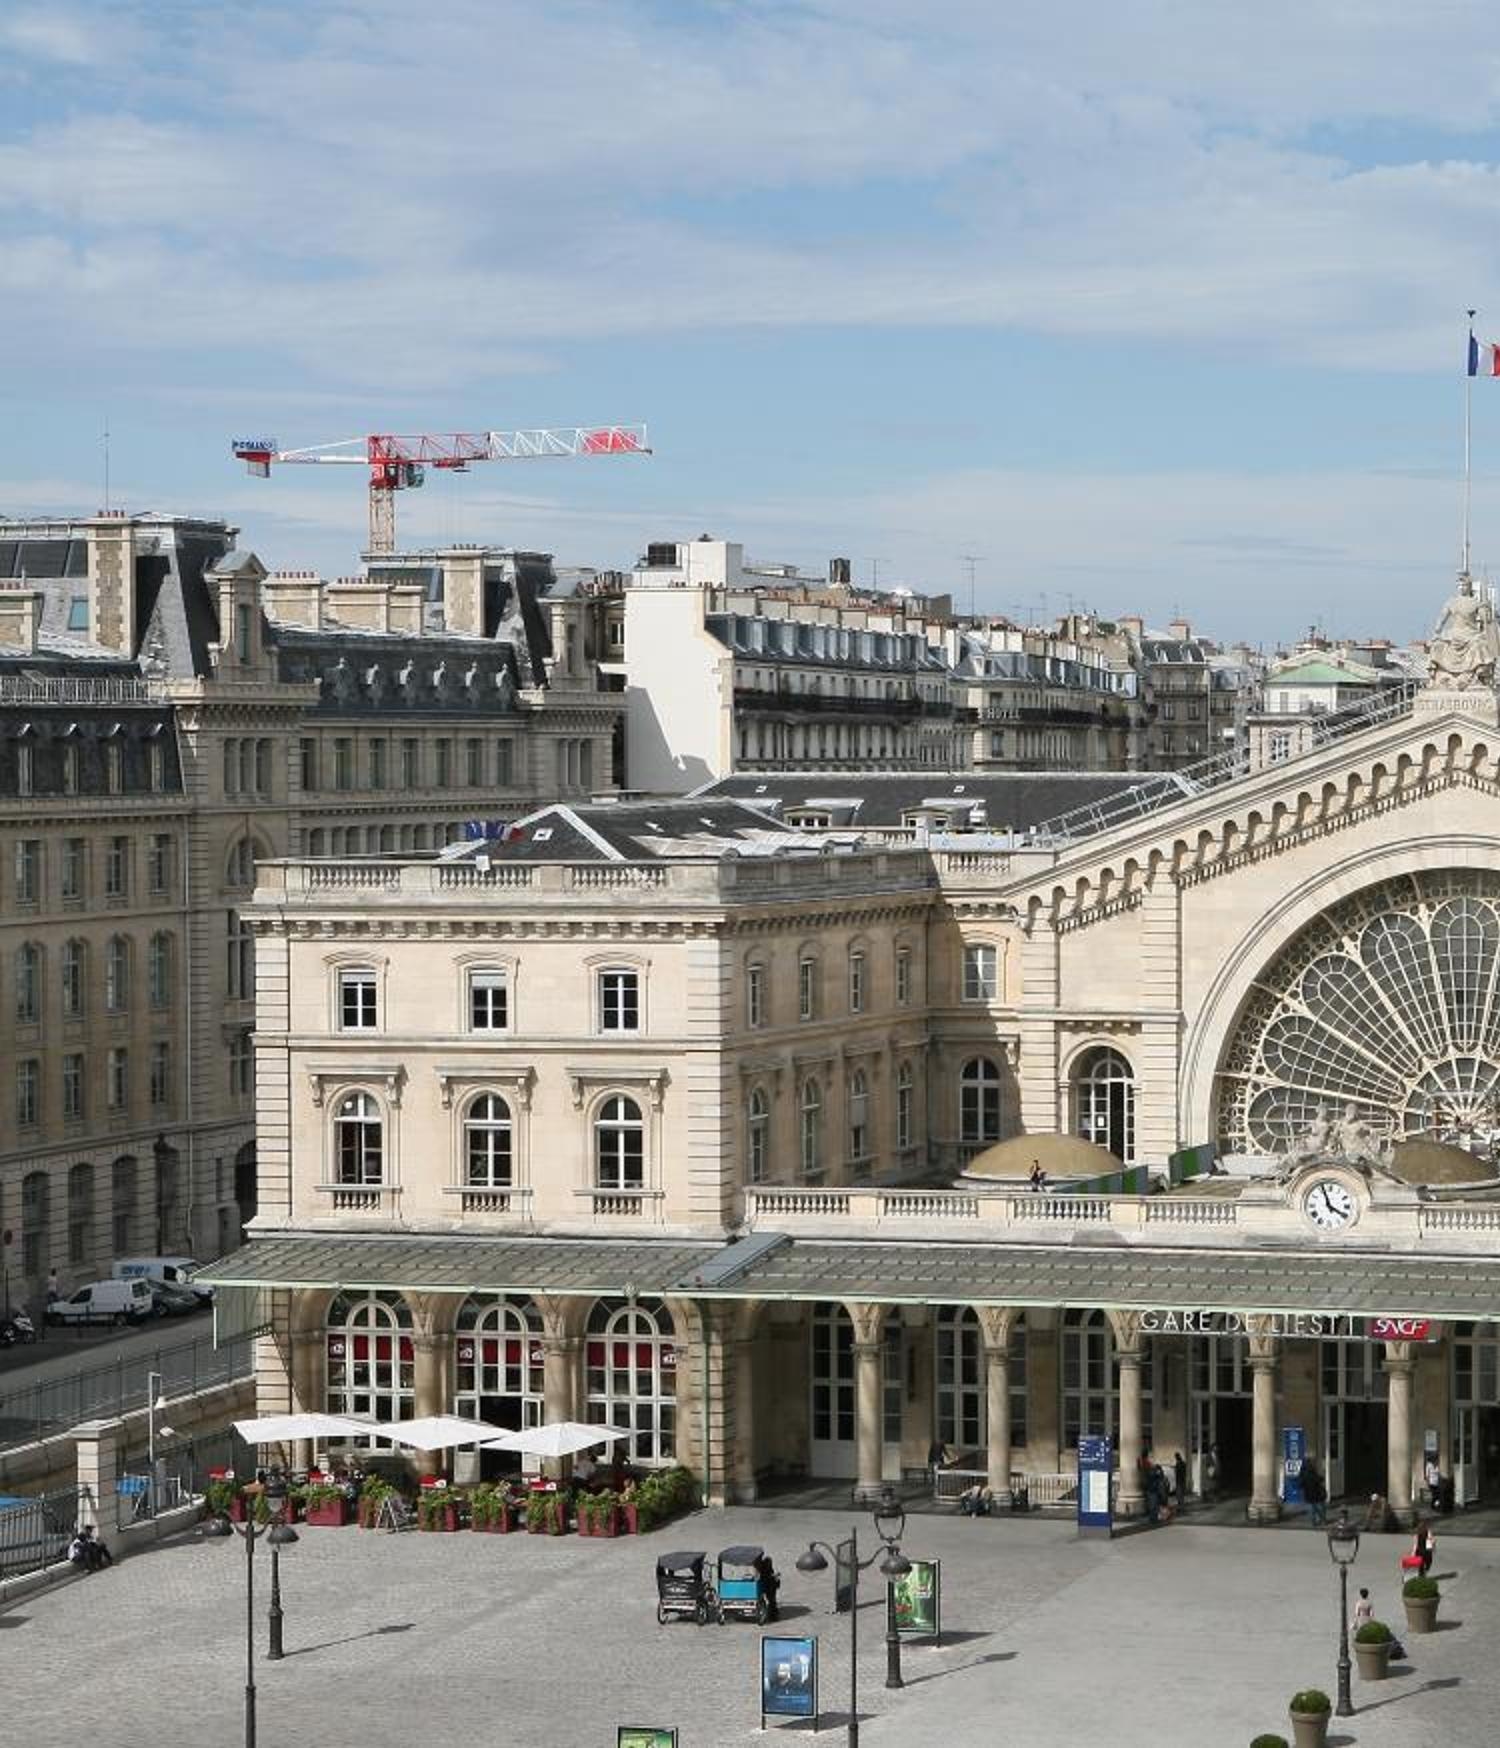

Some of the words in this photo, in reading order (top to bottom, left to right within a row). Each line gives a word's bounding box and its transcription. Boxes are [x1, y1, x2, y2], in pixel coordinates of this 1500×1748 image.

[1140, 1310, 1211, 1331] GARE
[1225, 1312, 1257, 1332] DE
[1271, 1313, 1339, 1334] LEST
[1374, 1318, 1424, 1335] SNCF
